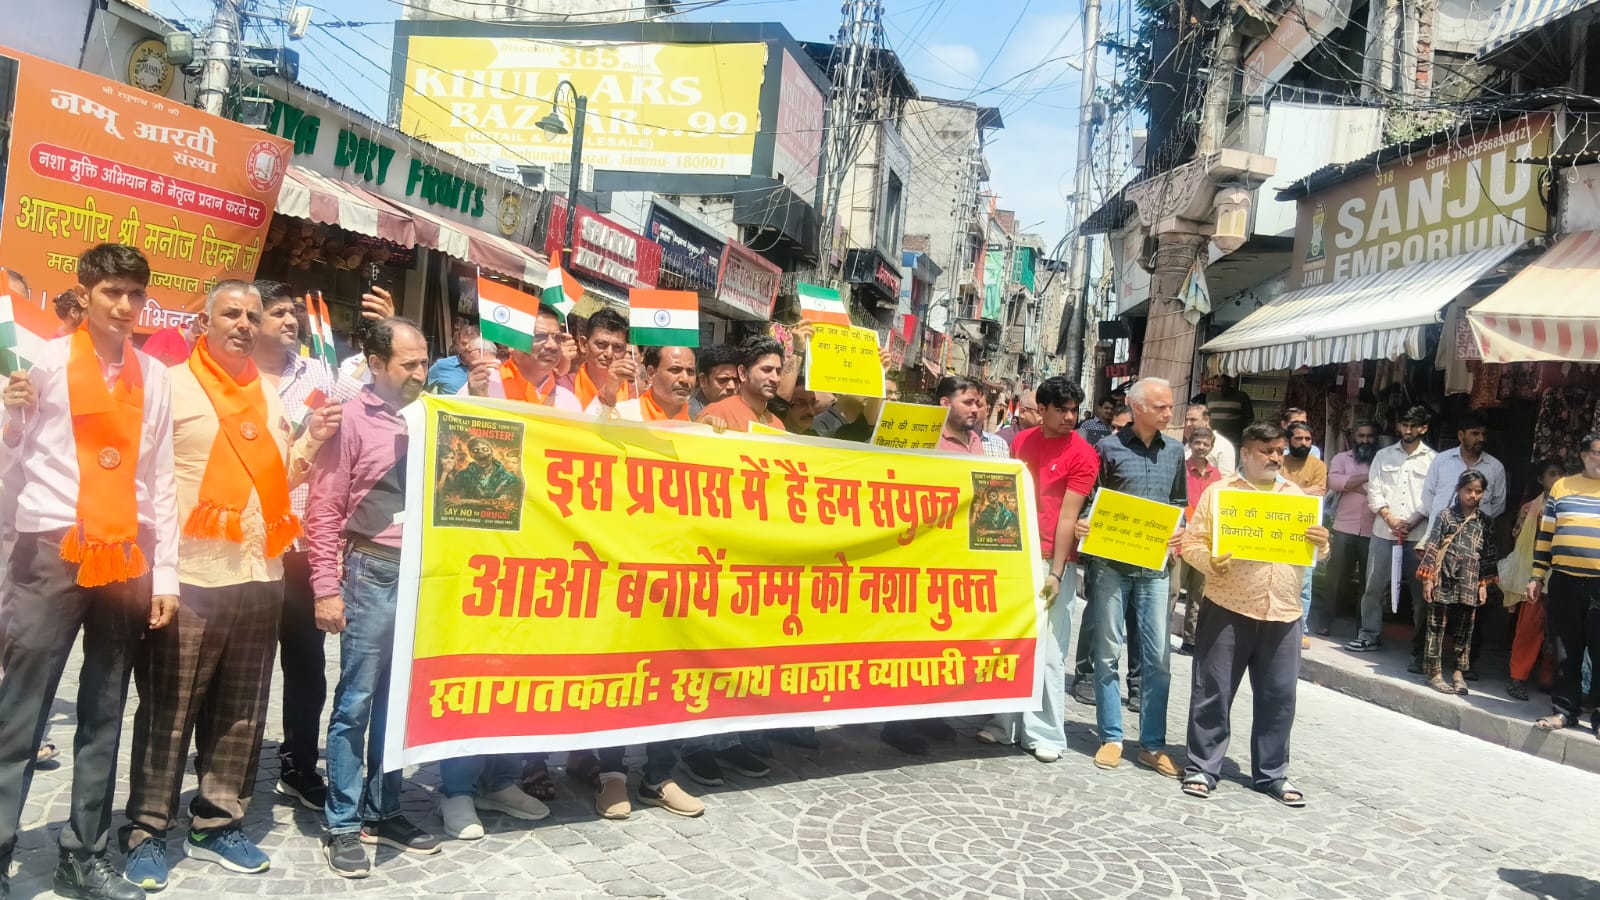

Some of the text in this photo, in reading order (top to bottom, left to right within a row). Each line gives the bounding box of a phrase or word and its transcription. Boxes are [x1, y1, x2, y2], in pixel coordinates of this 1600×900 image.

[559, 47, 620, 68] 365
[413, 68, 703, 106] KHULLARS
[50, 89, 218, 158] जम्मू आरती
[173, 150, 218, 174] संस्था
[333, 128, 396, 186] DRY
[405, 158, 488, 218] FRUITS
[39, 150, 260, 221] नशा मुक्ति अभियान को नेतृत्व प्रदान करने पर
[1335, 144, 1532, 249] SANJU
[15, 195, 261, 274] आदरणीय श्री मनोज सिन्हा जी
[1332, 208, 1527, 284] EMPORIUM
[1301, 269, 1324, 289] JAIN
[468, 427, 514, 441] MONSTER!
[471, 420, 497, 430] DRUGS
[880, 418, 895, 430] नशे
[897, 419, 908, 431] की
[444, 507, 458, 516] SAY
[460, 508, 473, 517] NO
[544, 448, 960, 546] इस प्रयास में हैं हम संयुक्त
[1220, 505, 1315, 524] नशे की आदत देगी
[1270, 528, 1283, 540] को
[462, 541, 998, 637] आओ बनायें जम्मू को नशा मुक्त
[671, 663, 775, 713] रघुनाथ
[780, 660, 863, 703] बाज़ार
[868, 648, 966, 690] व्यापारी
[972, 647, 1020, 683] संघ
